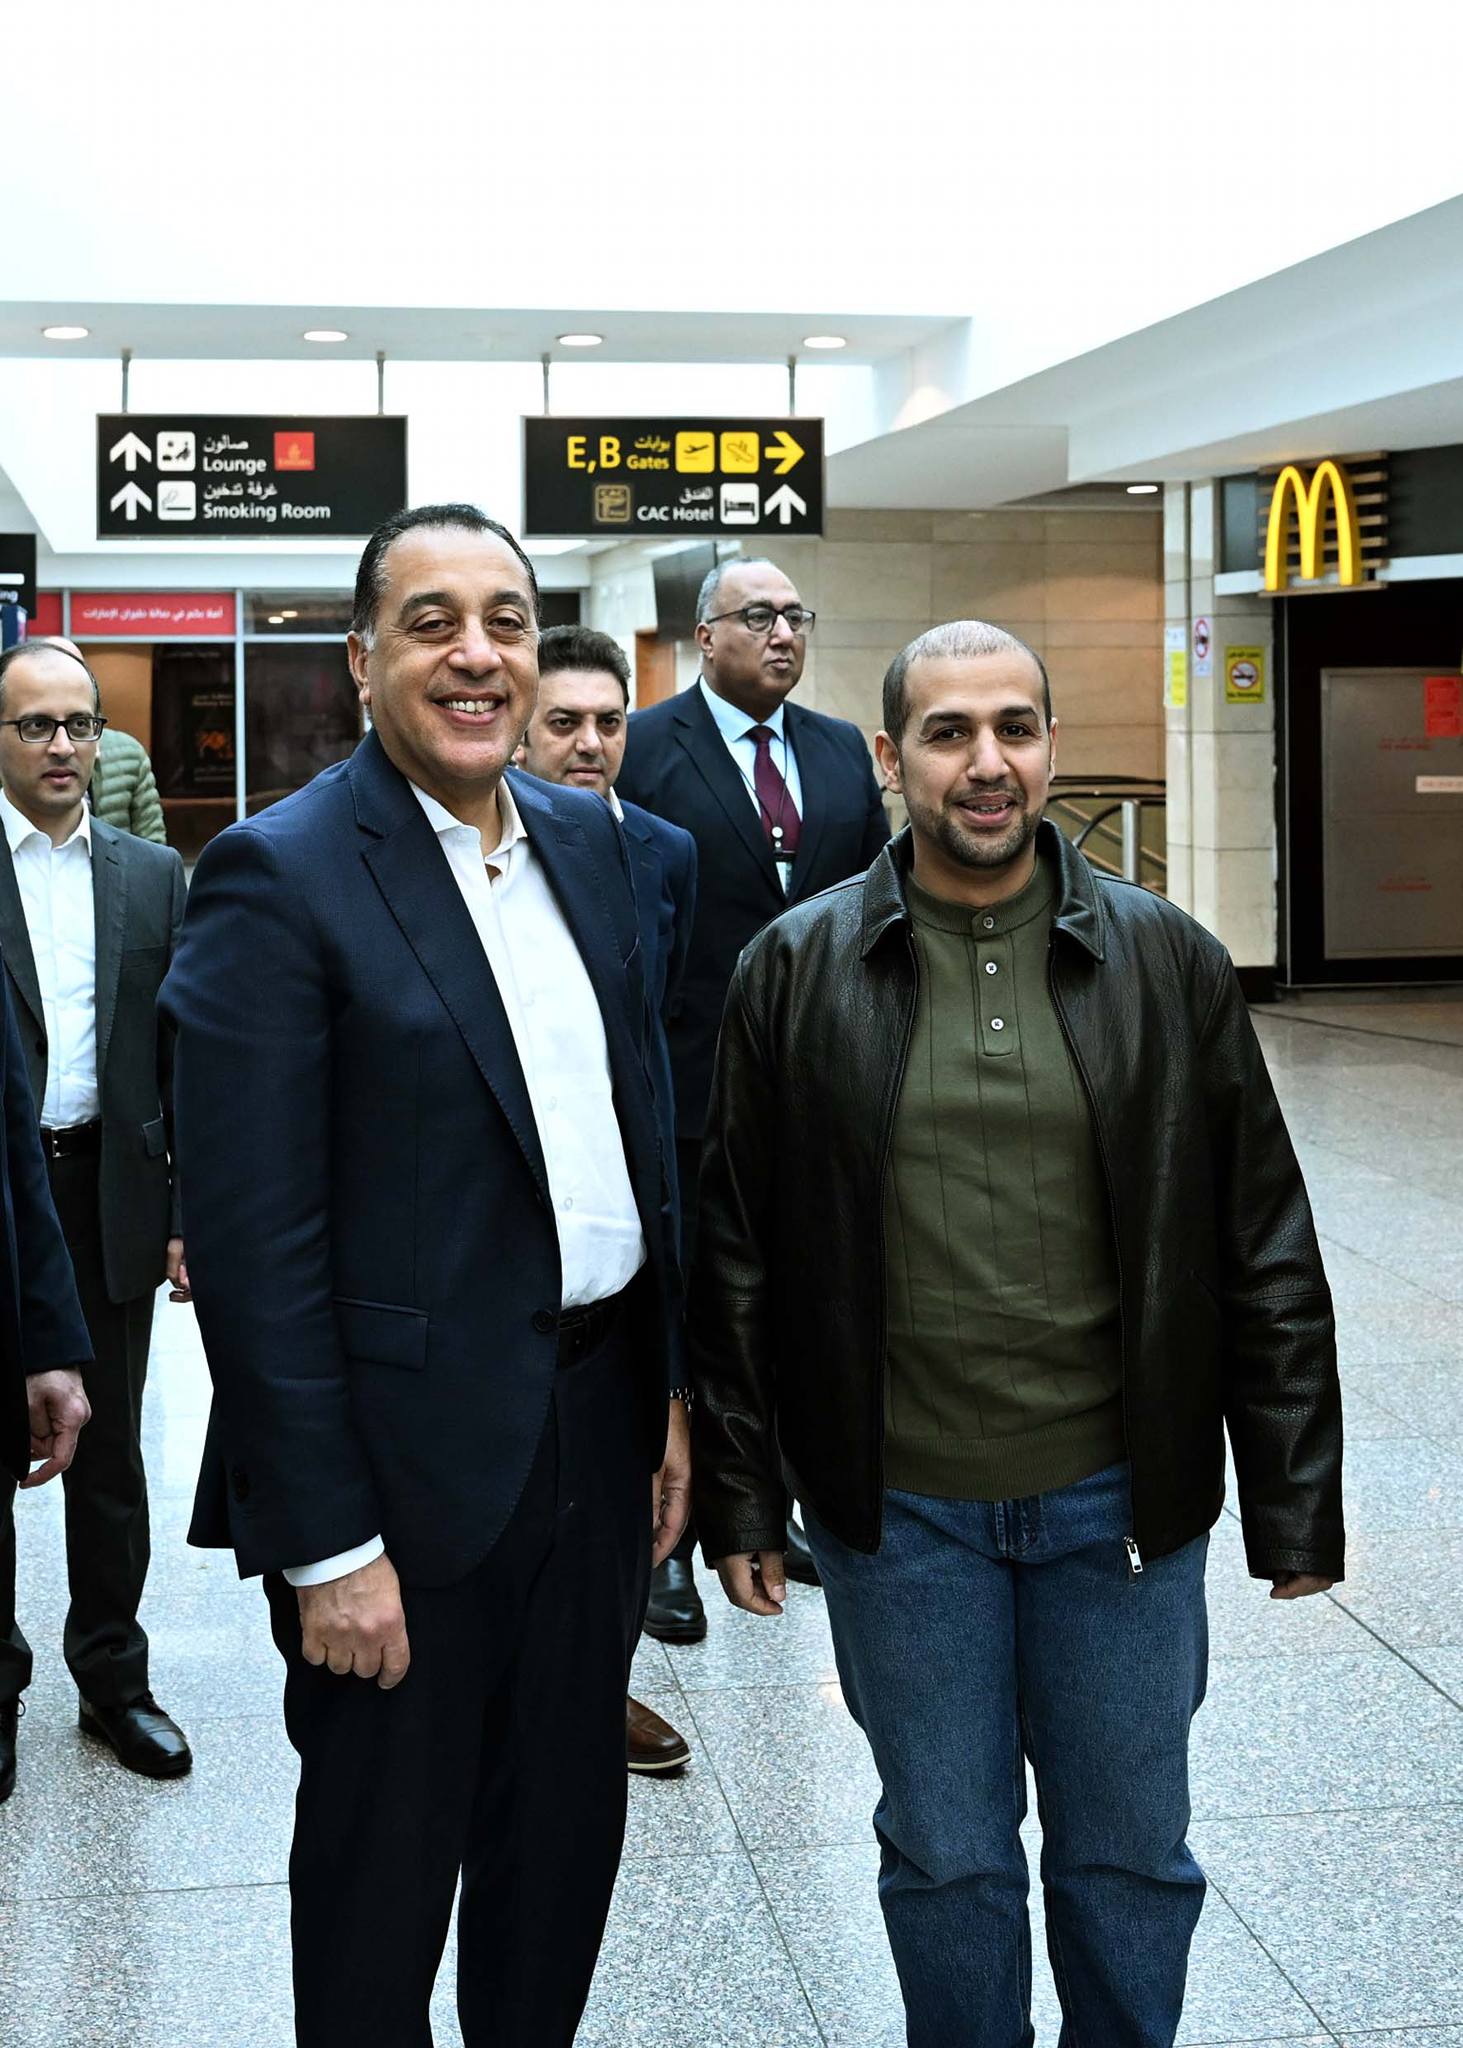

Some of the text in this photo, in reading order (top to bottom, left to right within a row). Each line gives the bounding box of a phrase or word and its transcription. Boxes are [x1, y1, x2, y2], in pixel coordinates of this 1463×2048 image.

[203, 435, 249, 453] صالون
[634, 435, 670, 452] بوابات
[567, 436, 621, 474] E,B
[626, 454, 670, 470] Gates
[203, 456, 267, 476] Lounge
[203, 481, 278, 501] غرفة تدخين
[679, 486, 714, 504] الفندق
[203, 502, 331, 523] Smoking Room
[637, 506, 714, 521] CAC Hotel
